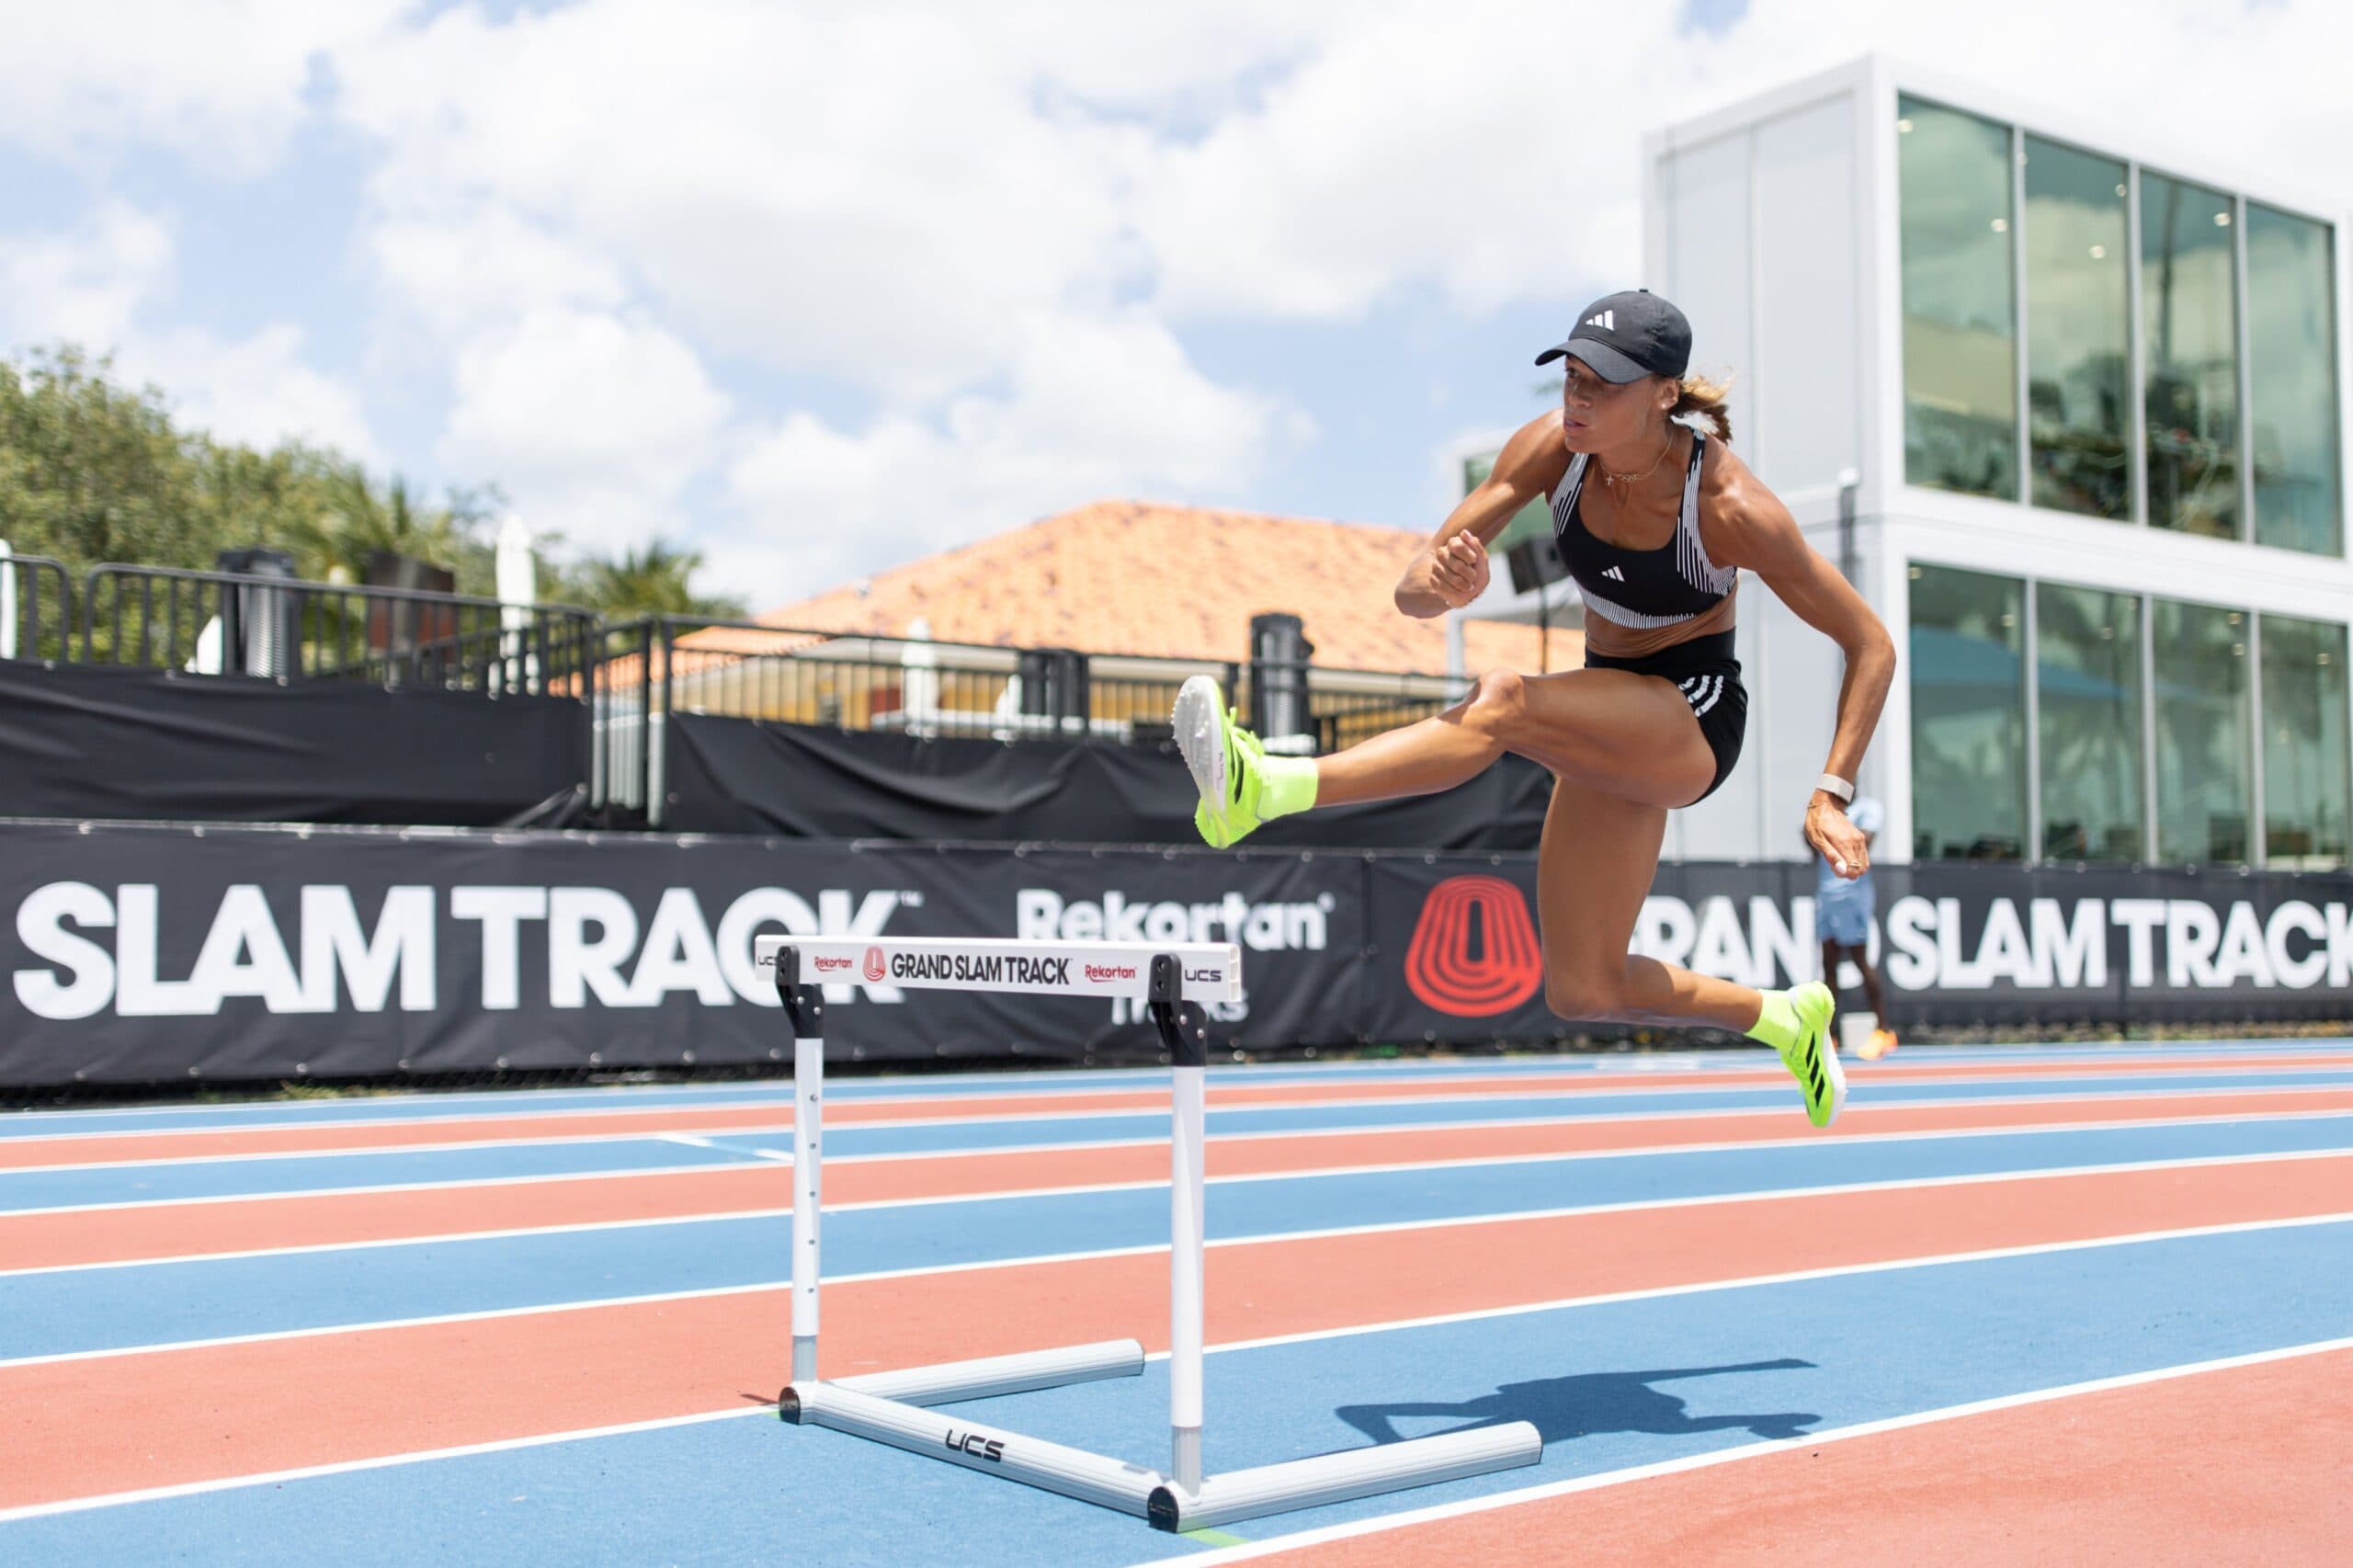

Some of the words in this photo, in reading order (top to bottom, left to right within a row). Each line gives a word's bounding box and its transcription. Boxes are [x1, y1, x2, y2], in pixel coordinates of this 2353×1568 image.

[13, 881, 437, 1019] SLAM
[1886, 895, 2107, 990] SLAM
[814, 957, 853, 971] Rekortan
[892, 953, 952, 980] GRAND
[955, 955, 1002, 983] SLAM
[1005, 957, 1070, 985] TRACK
[1085, 964, 1136, 982] Rekortan
[1185, 970, 1222, 983] UCS
[946, 1428, 1006, 1463] UCS
